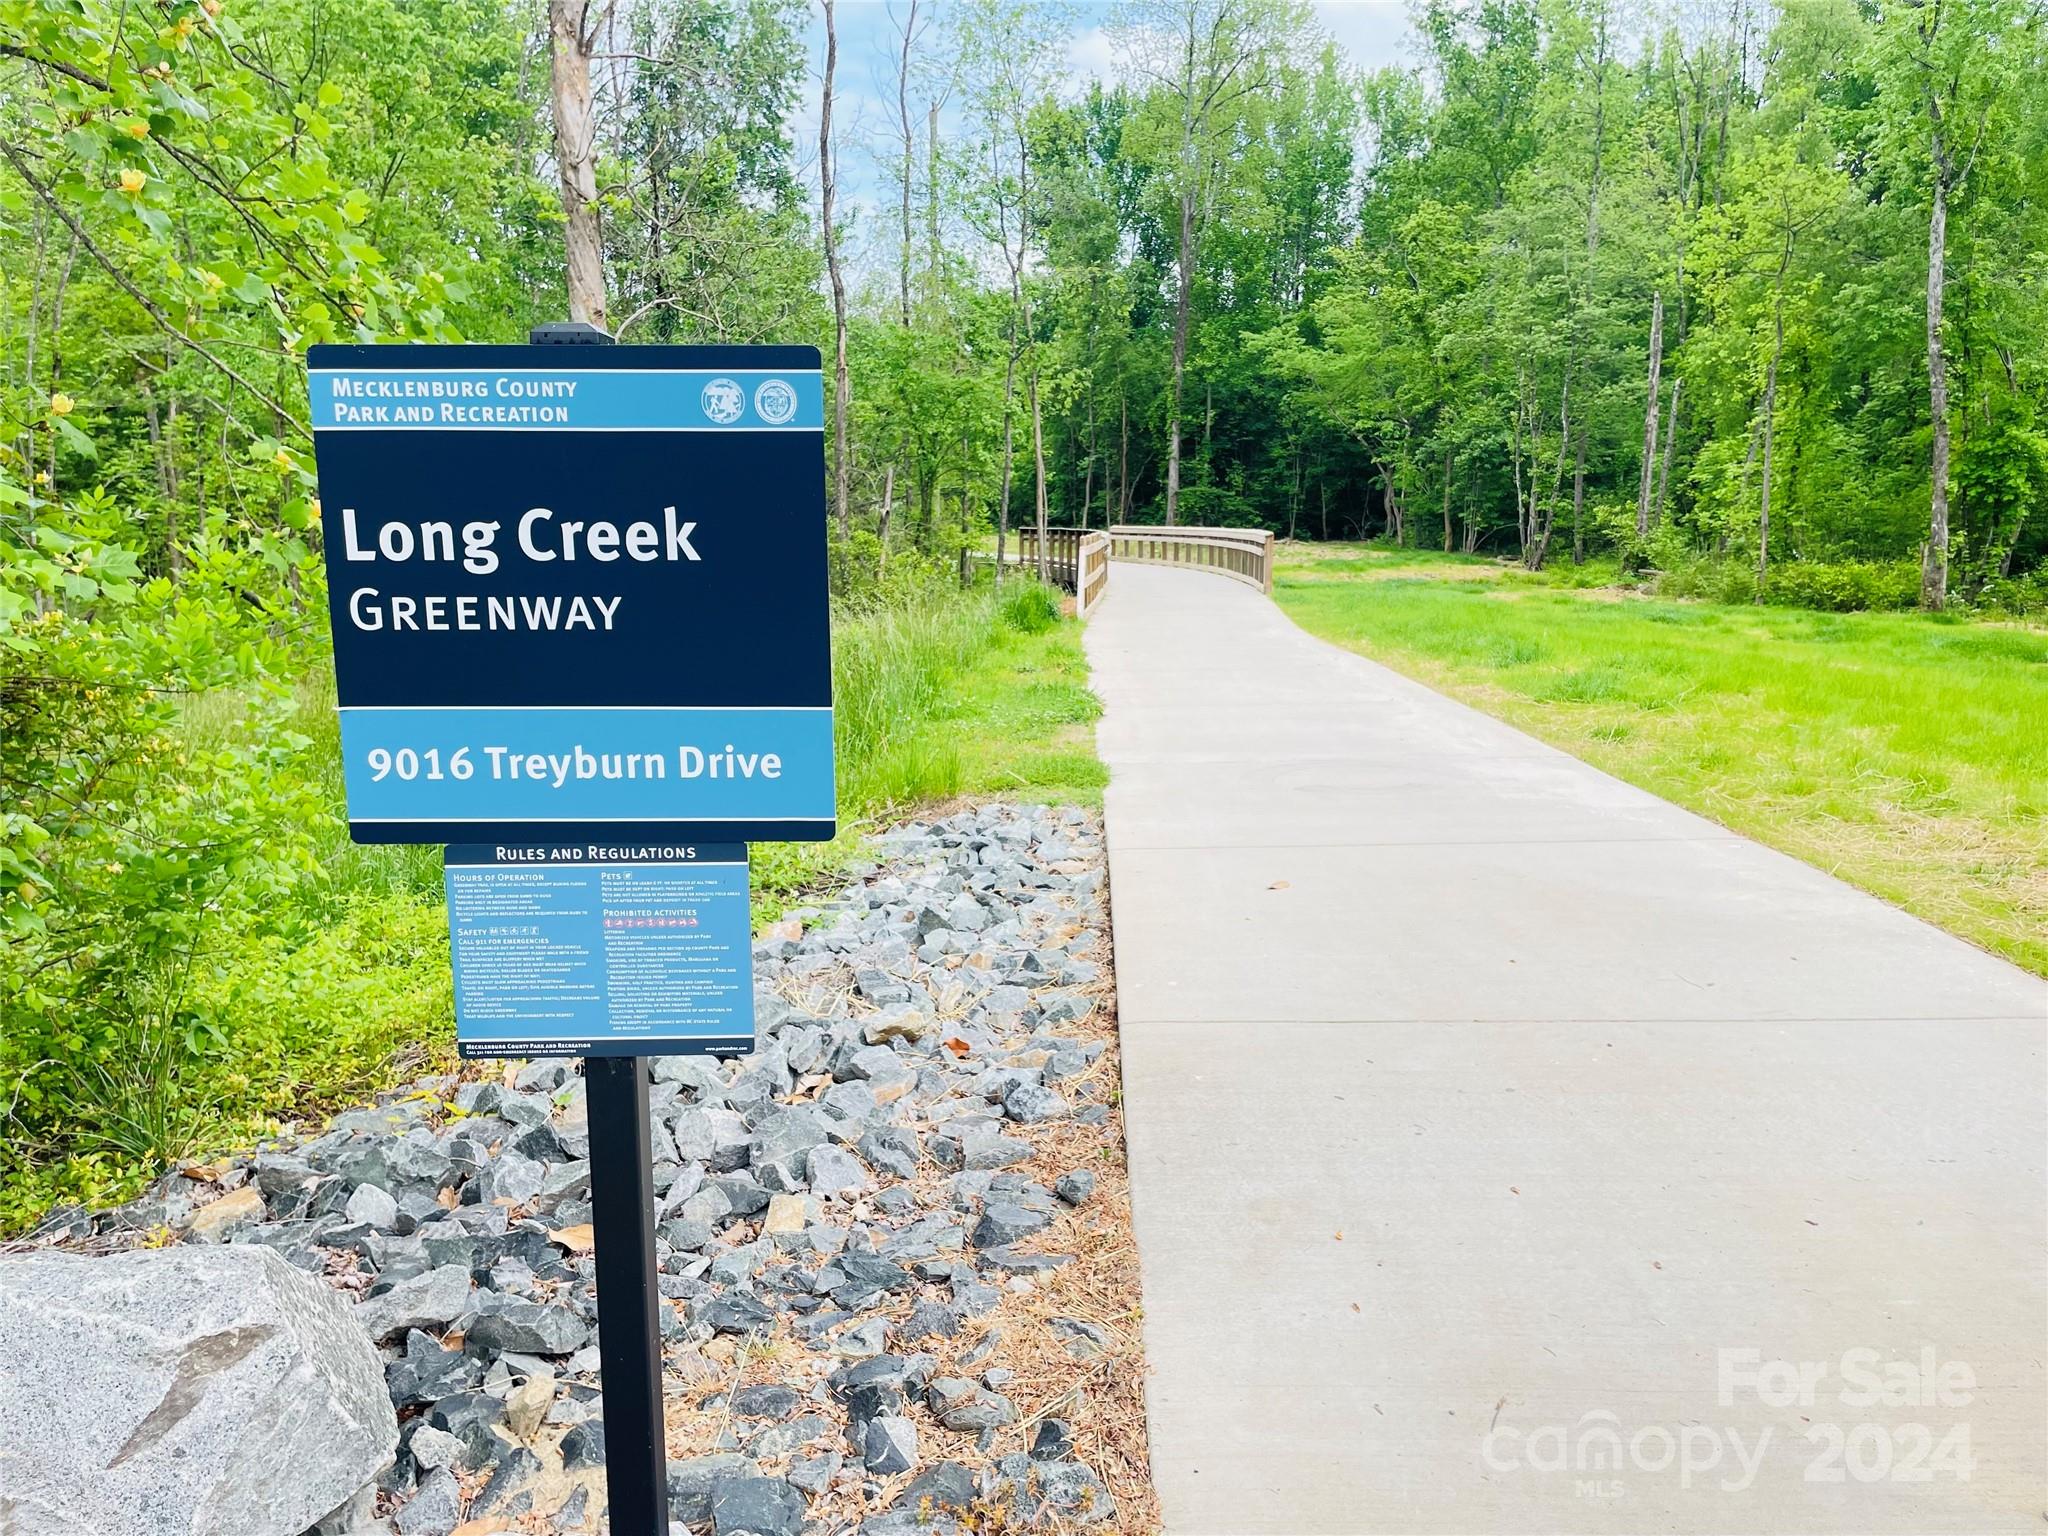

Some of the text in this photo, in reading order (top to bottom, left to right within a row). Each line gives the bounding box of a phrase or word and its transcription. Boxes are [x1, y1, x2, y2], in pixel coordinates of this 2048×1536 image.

[333, 378, 576, 397] MECKLENBURG COUNTY
[335, 403, 568, 422] PARK AND RECREATION
[343, 506, 701, 574] Long Creek
[350, 588, 621, 630] GREENWAY
[368, 744, 781, 788] 9016 Treyburn Drive
[496, 846, 695, 860] RULES AND REGULATIONS
[601, 872, 621, 880] PETS
[604, 909, 652, 917] PROHIBITED
[458, 928, 487, 936] SAFETY
